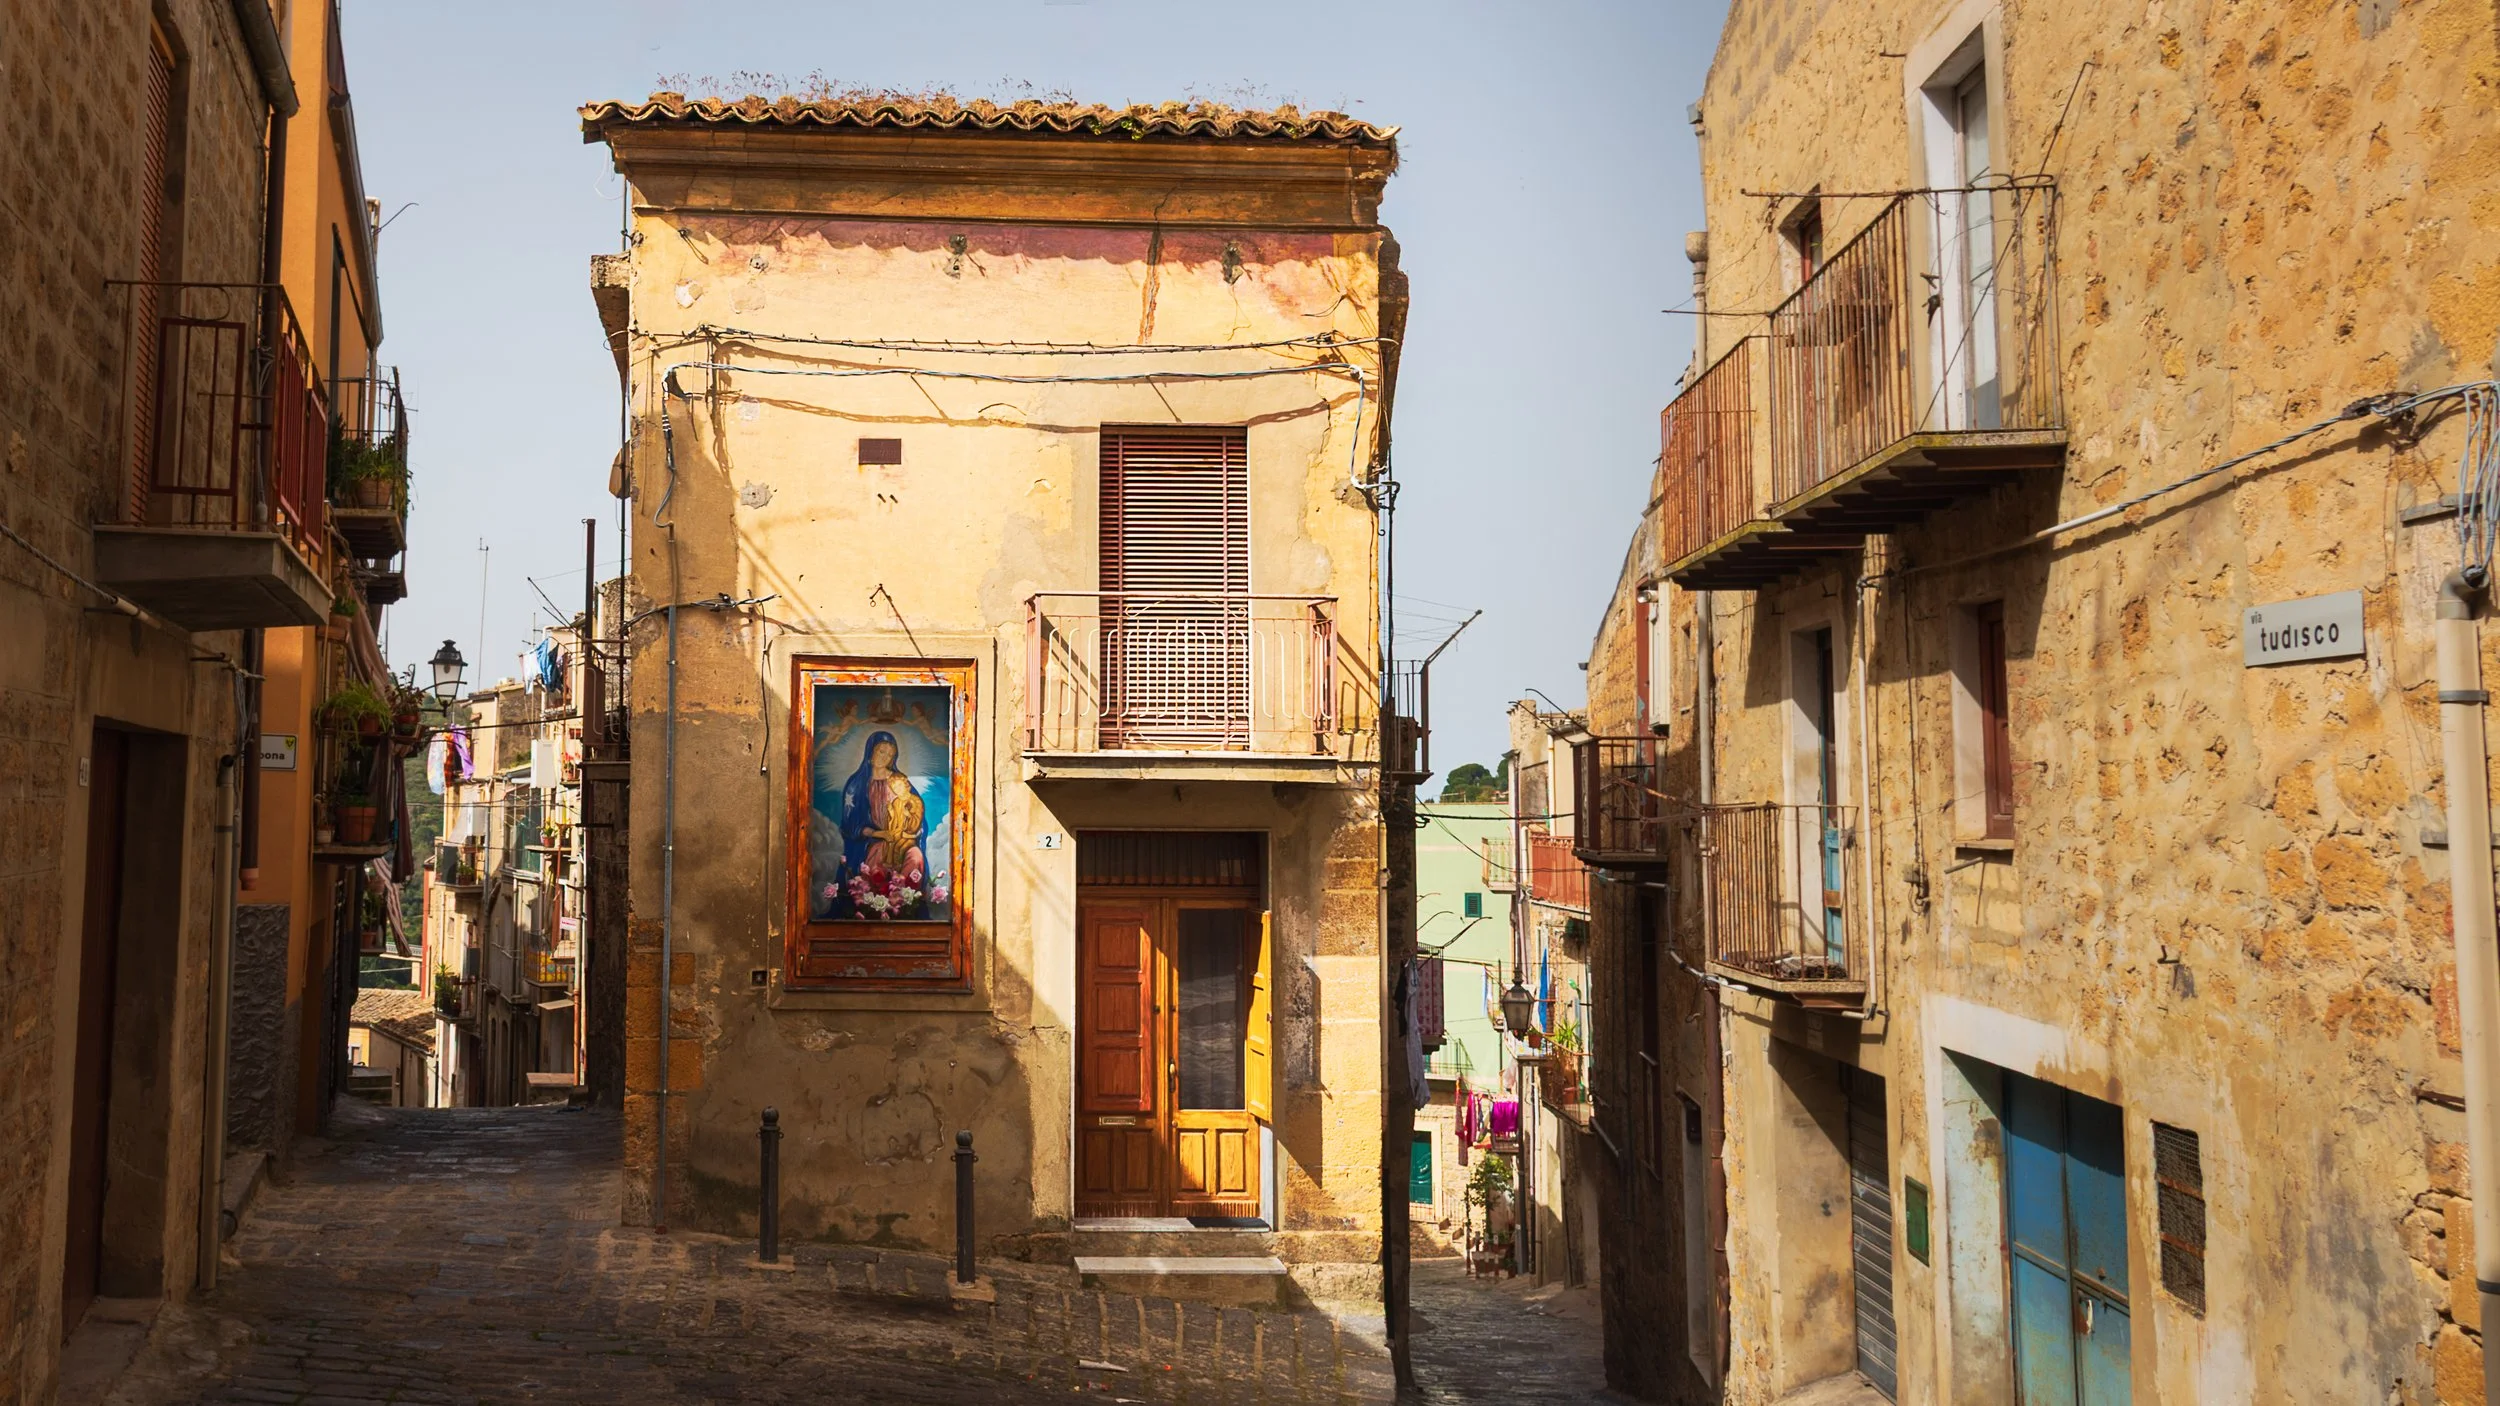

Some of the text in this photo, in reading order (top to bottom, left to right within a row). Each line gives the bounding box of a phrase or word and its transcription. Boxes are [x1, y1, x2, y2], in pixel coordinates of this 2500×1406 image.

[2251, 611, 2263, 624] via
[2260, 623, 2339, 652] tudisco
[1045, 835, 1052, 847] 2
